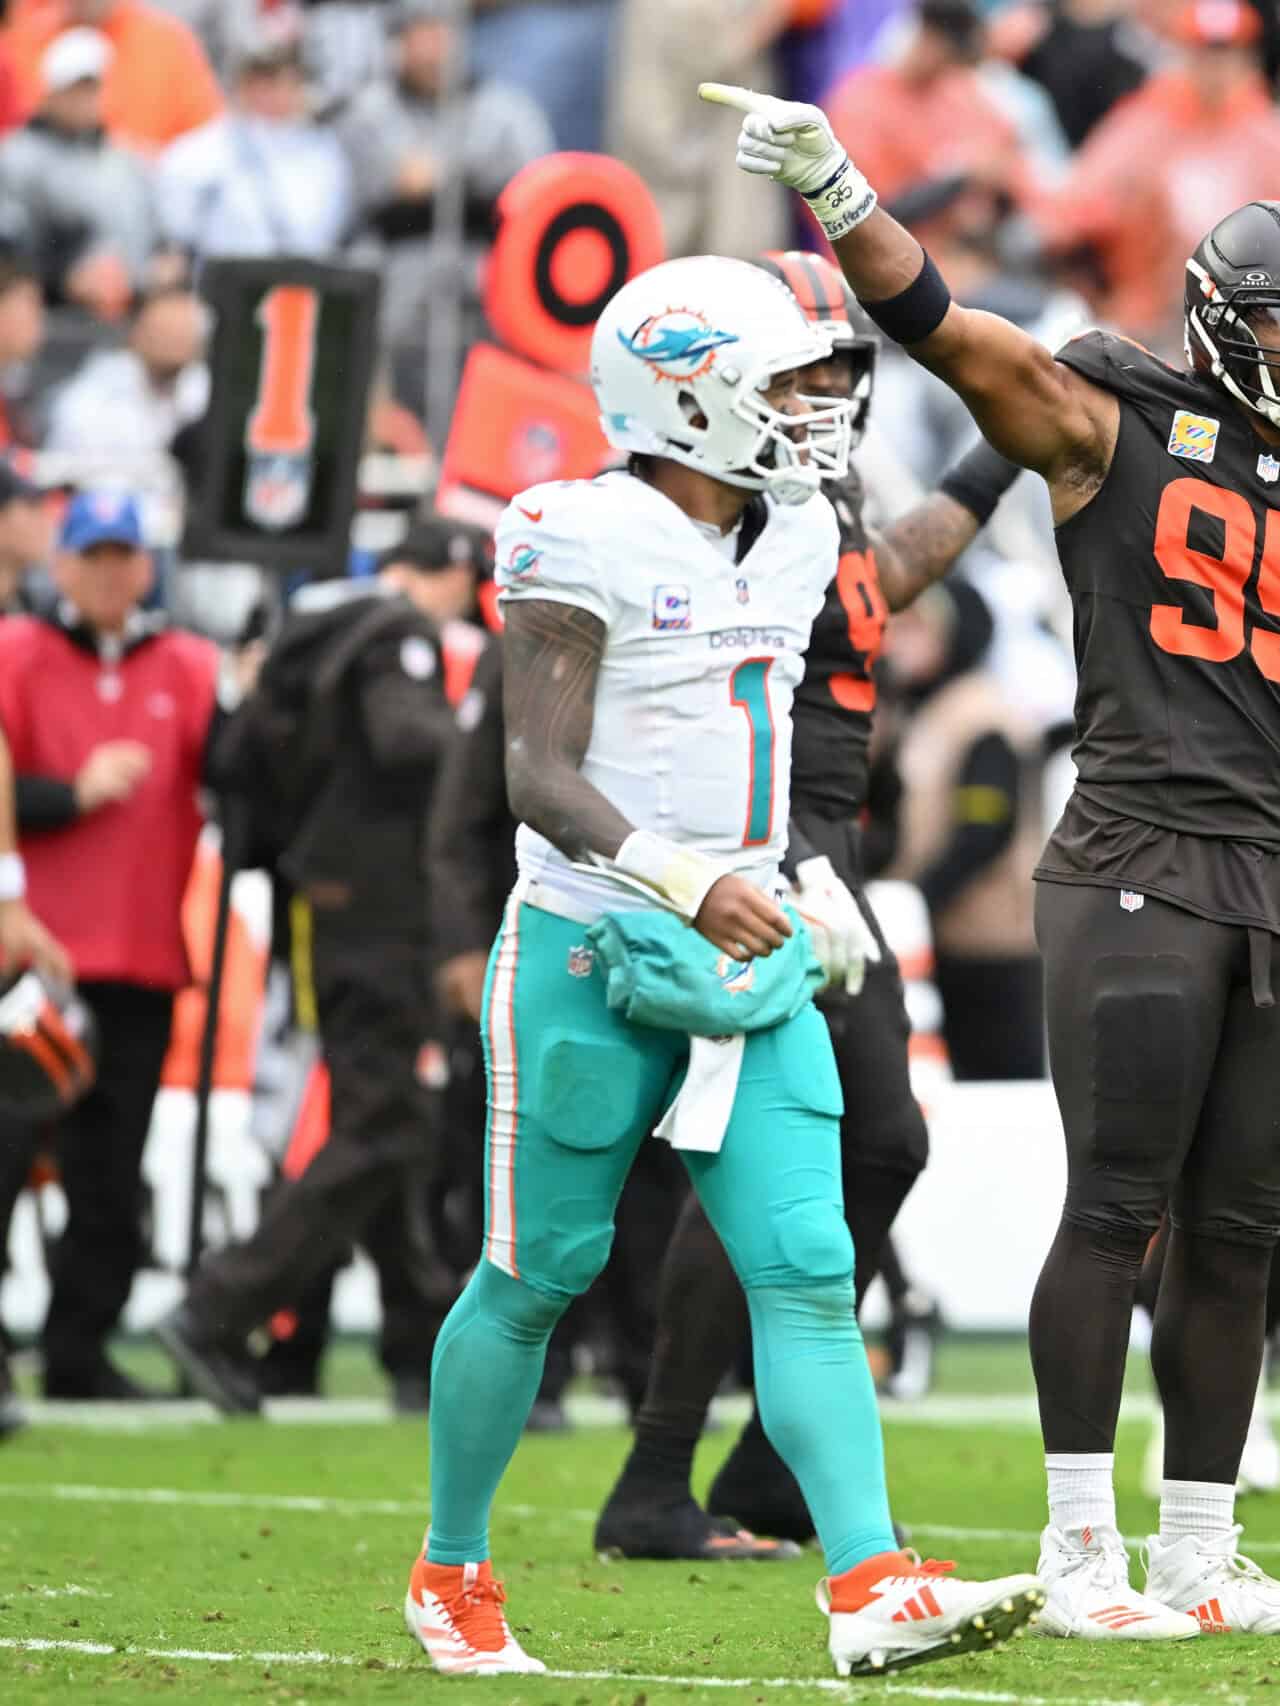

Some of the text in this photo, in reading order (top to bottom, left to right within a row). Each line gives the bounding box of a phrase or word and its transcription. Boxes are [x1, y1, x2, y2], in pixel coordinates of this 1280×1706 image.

[826, 180, 853, 208] 25
[246, 285, 318, 453] 1
[828, 547, 888, 712] 9
[729, 656, 775, 846] 1
